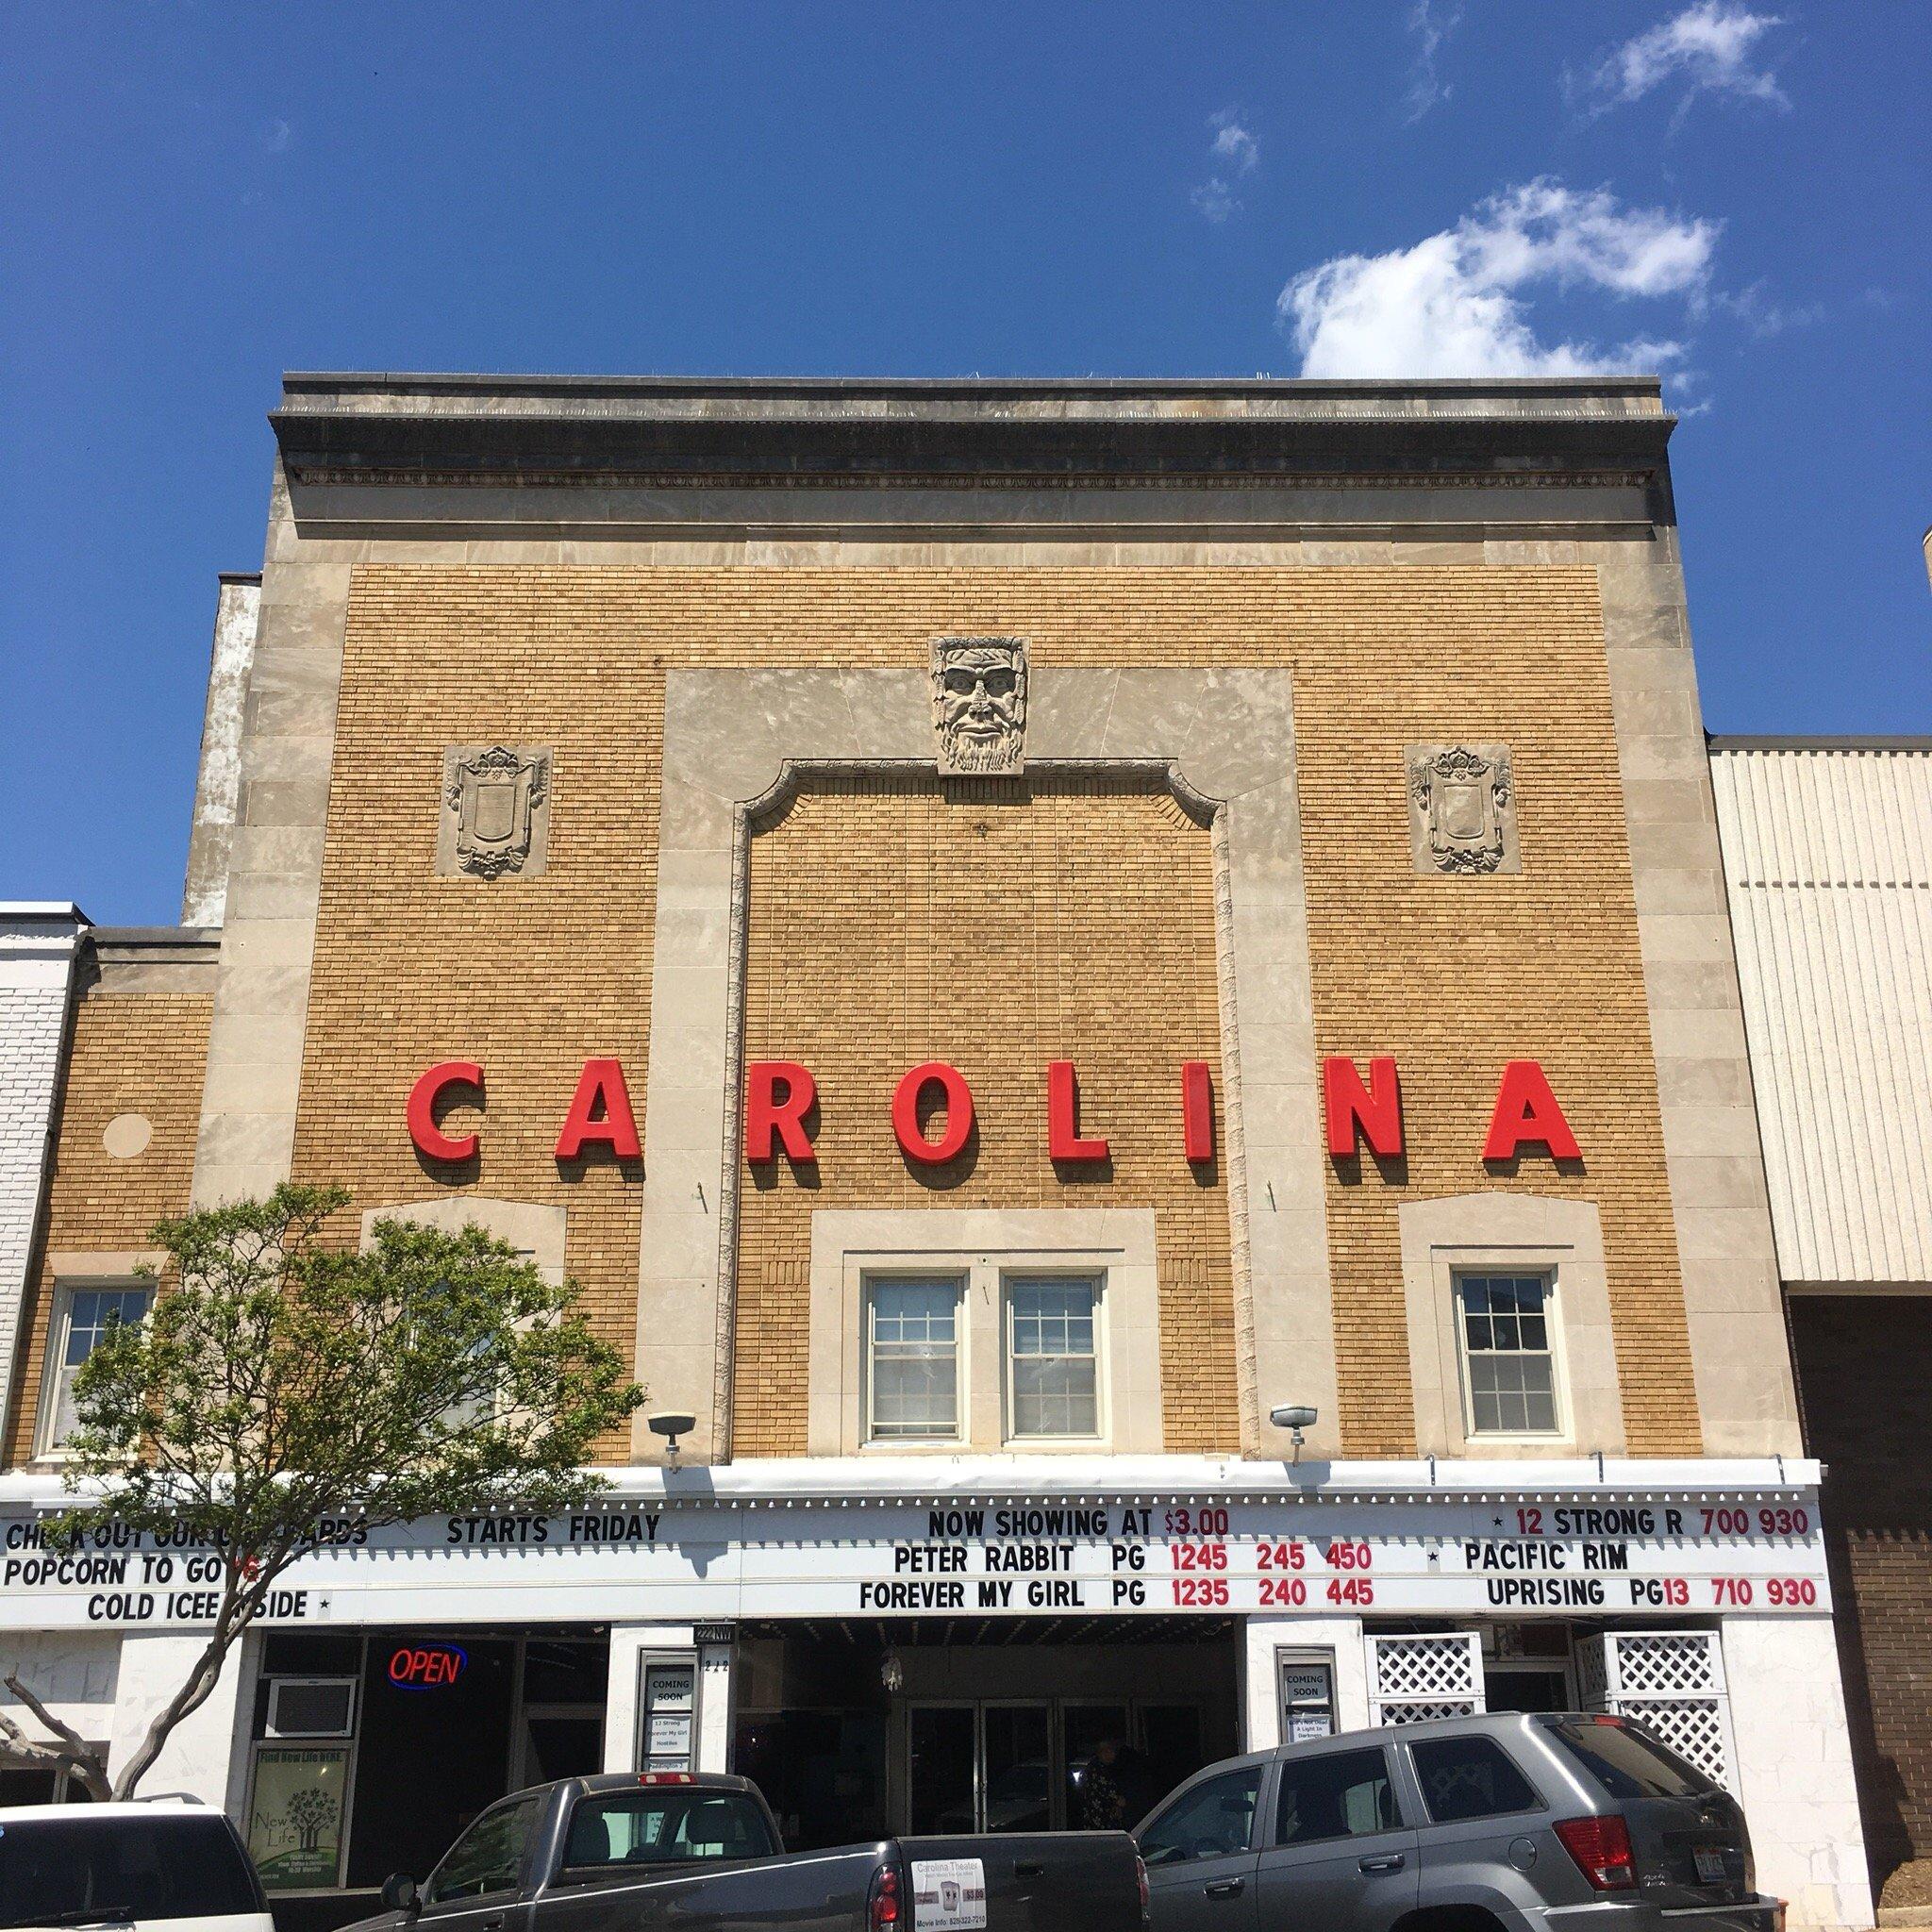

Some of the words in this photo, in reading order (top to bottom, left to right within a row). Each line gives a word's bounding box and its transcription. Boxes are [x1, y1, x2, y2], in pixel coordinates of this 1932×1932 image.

[407, 1056, 1584, 1166] CAROLINA
[447, 1515, 549, 1543] STARTS
[570, 1514, 660, 1542] FRIDAY
[928, 1509, 985, 1538] NOW
[996, 1509, 1108, 1538] SHOWING
[1121, 1508, 1153, 1537] AT
[1164, 1508, 1229, 1536] $3.00
[1516, 1508, 1544, 1536] 12
[1557, 1508, 1656, 1536] STRONG
[1666, 1508, 1684, 1535] R
[1700, 1508, 1750, 1535] 700
[1759, 1508, 1809, 1535] 930
[894, 1546, 968, 1574] PETER
[985, 1545, 1074, 1573] RABBIT
[1112, 1544, 1146, 1572] PG
[1171, 1543, 1229, 1571] 1245
[1257, 1543, 1306, 1571] 245
[1325, 1543, 1373, 1570] 450
[1466, 1543, 1566, 1570] PACIFIC
[1584, 1542, 1629, 1570] RIM
[4, 1557, 127, 1587] POPCORN
[142, 1557, 174, 1584] TO
[186, 1557, 223, 1584] GO
[859, 1581, 965, 1609] FOREVER
[977, 1580, 1014, 1608] MY
[1027, 1580, 1086, 1607] GIRL
[1113, 1579, 1146, 1607] PG
[1172, 1578, 1230, 1607] 1235
[1258, 1578, 1307, 1606] 240
[1325, 1578, 1374, 1606] 445
[1487, 1578, 1605, 1606] UPRISING
[1630, 1577, 1690, 1606] PG13
[1710, 1577, 1753, 1606] 710
[1767, 1577, 1817, 1606] 930
[88, 1592, 155, 1621] COLD
[166, 1591, 220, 1620] ICEE
[388, 1649, 462, 1685] OPEN
[1287, 1675, 1324, 1684] COMING
[652, 1680, 690, 1689] COMING
[658, 1692, 683, 1701] SOON
[1293, 1688, 1319, 1696] SOON
[256, 1811, 288, 1829] New
[267, 1826, 295, 1847] Life
[917, 1862, 949, 1873] Carolina
[950, 1860, 978, 1872] Theater
